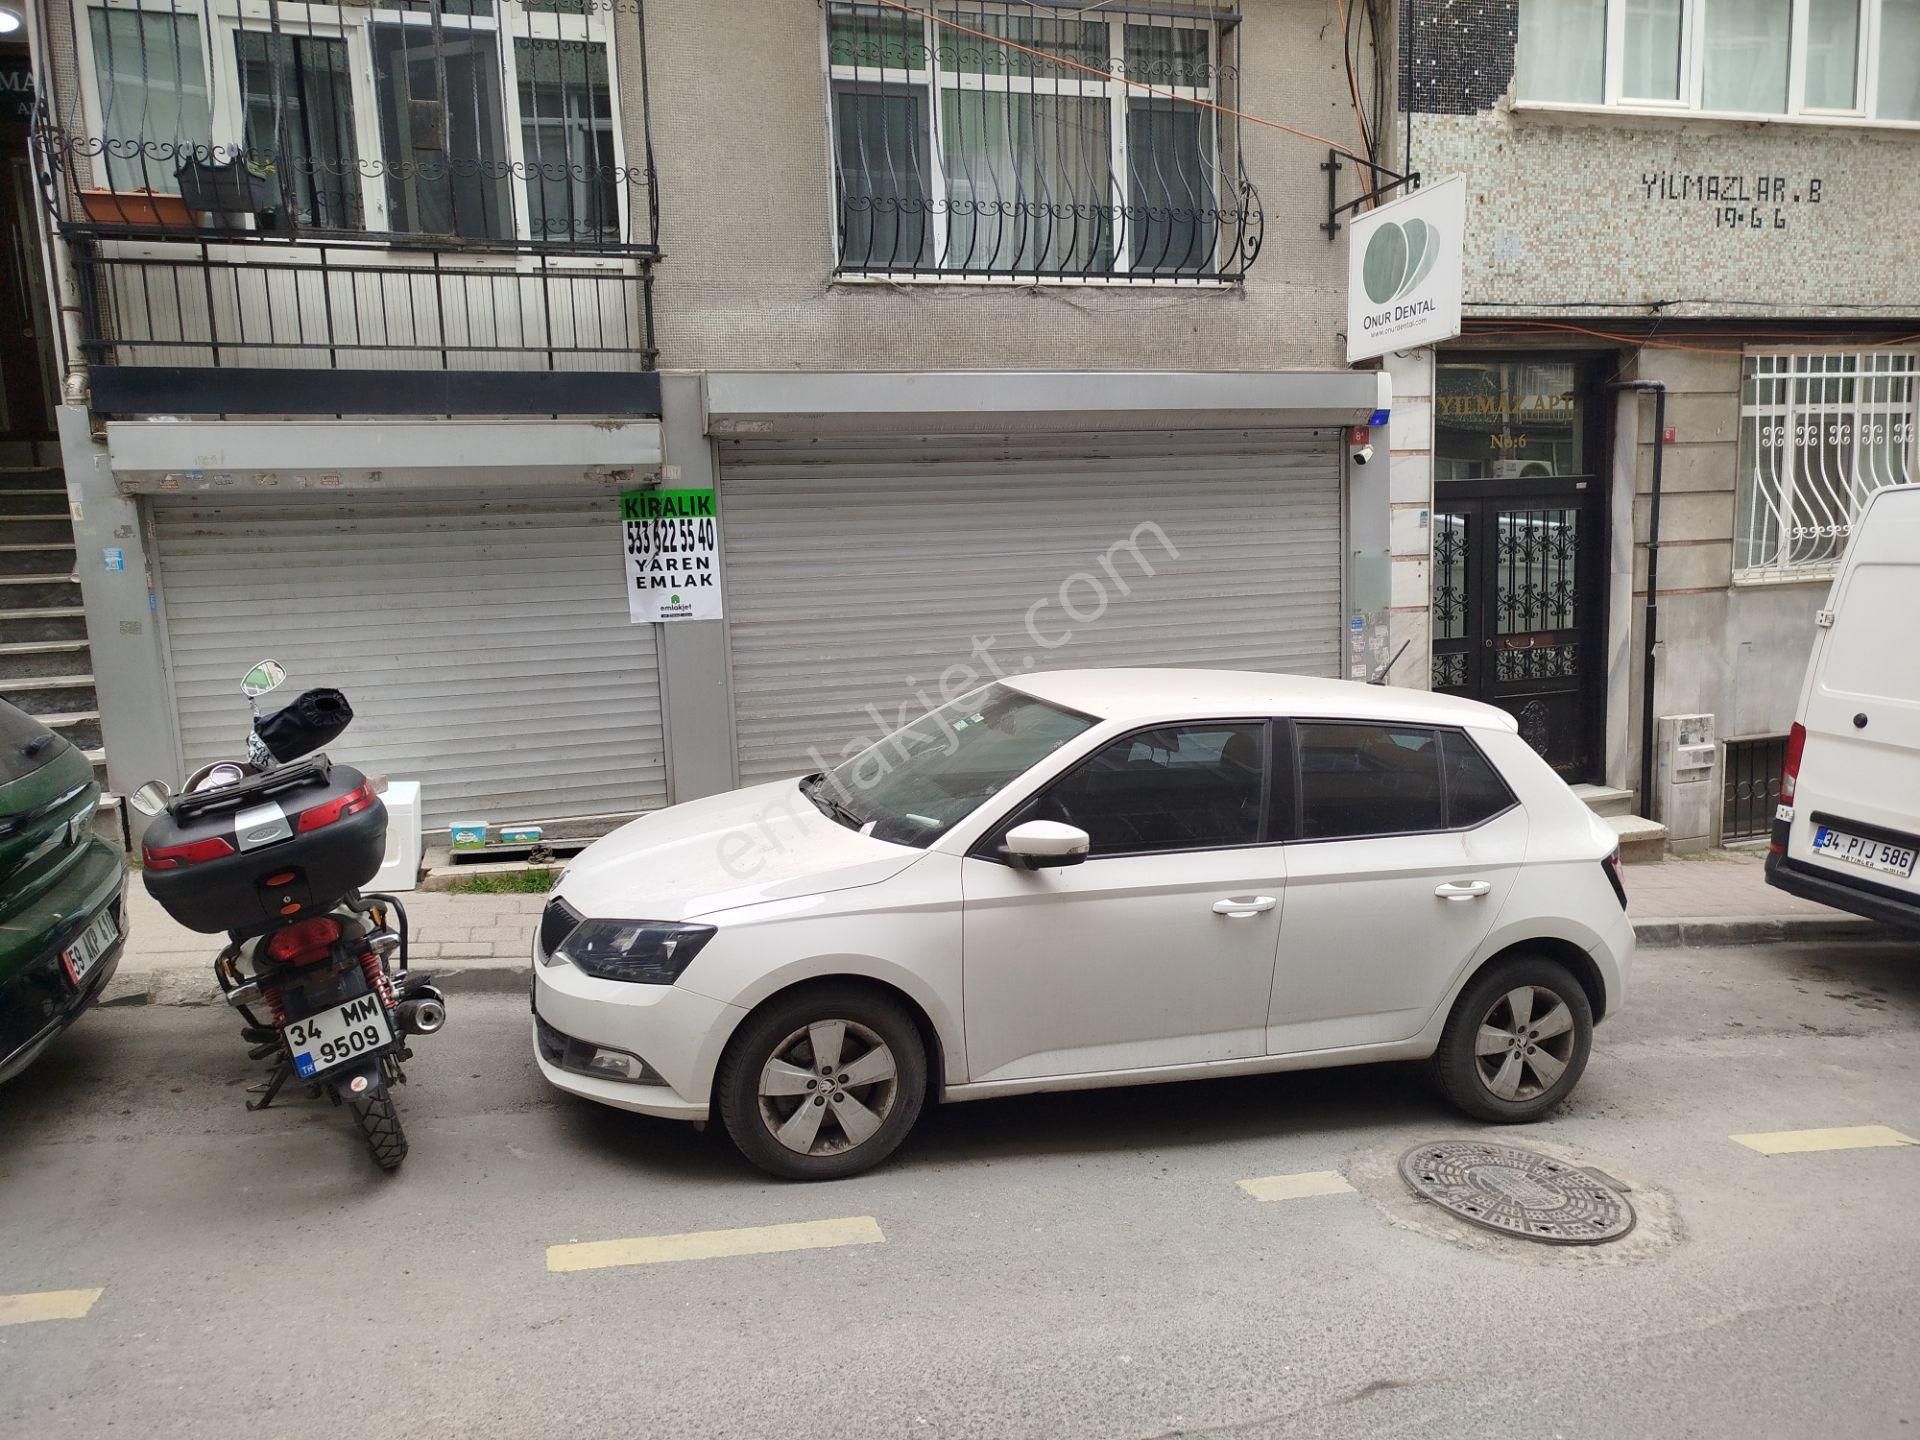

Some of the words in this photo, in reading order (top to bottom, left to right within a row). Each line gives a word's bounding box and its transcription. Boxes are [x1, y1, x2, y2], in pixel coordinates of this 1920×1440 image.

[1490, 433, 1527, 449] No:6
[625, 493, 712, 519] KİRALIK
[627, 520, 650, 554] 533
[653, 518, 677, 553] 622
[680, 519, 694, 552] 55
[698, 518, 714, 551] 40
[635, 556, 709, 572] YAREN
[636, 573, 713, 589] EMLAK
[660, 603, 692, 611] emlakjet
[1823, 832, 1840, 850] 34
[1847, 837, 1877, 859] PIJ
[1880, 846, 1910, 868] 586
[290, 1020, 322, 1046] 34
[340, 995, 378, 1027] MM
[320, 1025, 380, 1064] 9509
[302, 1065, 314, 1075] TR
